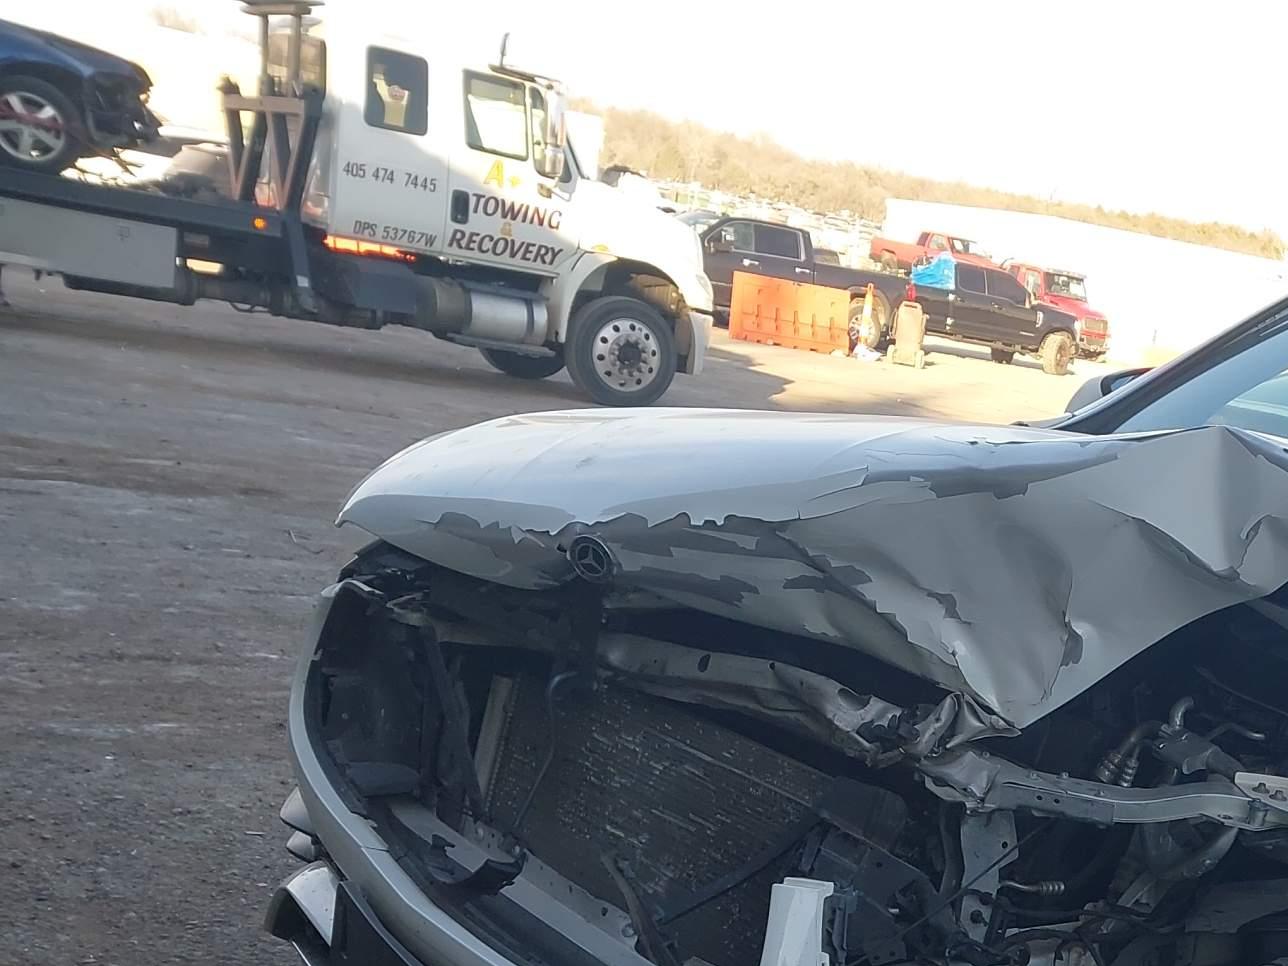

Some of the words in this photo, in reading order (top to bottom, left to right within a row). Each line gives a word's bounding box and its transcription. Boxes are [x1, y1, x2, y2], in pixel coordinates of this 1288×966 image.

[342, 161, 367, 179] 405
[372, 167, 394, 185] 474
[404, 172, 437, 193] 7445
[472, 193, 563, 229] TOWING
[353, 220, 378, 238] DPS
[448, 229, 564, 266] RECOVERY
